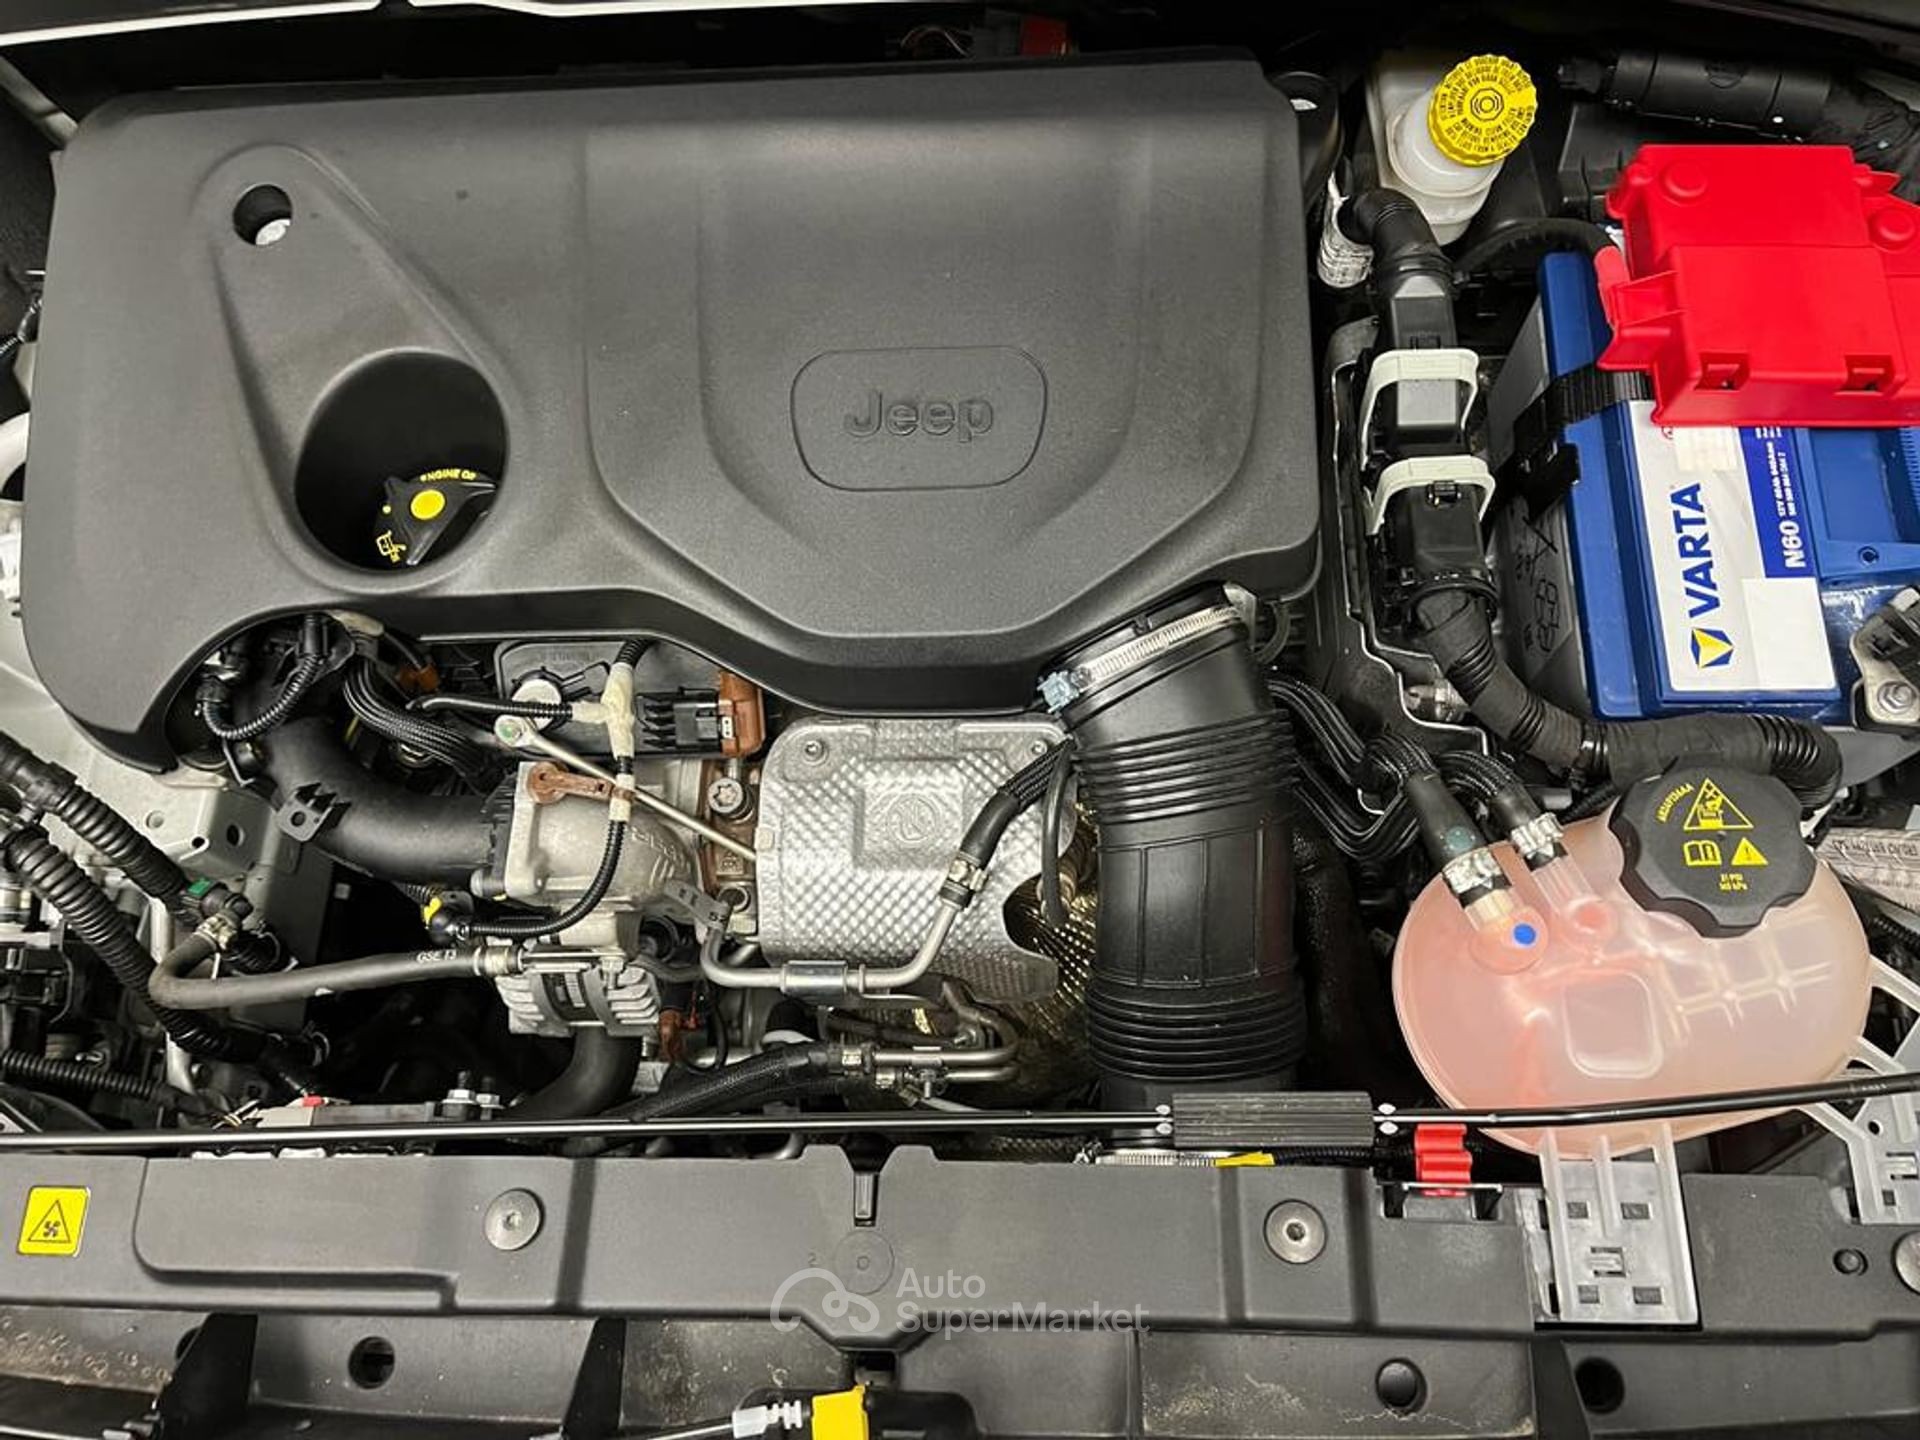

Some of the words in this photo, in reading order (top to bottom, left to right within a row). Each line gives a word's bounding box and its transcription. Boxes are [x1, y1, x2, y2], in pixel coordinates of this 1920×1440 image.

[844, 391, 994, 444] Jeep
[1670, 482, 1721, 618] VARTA
[1778, 520, 1807, 568] N60
